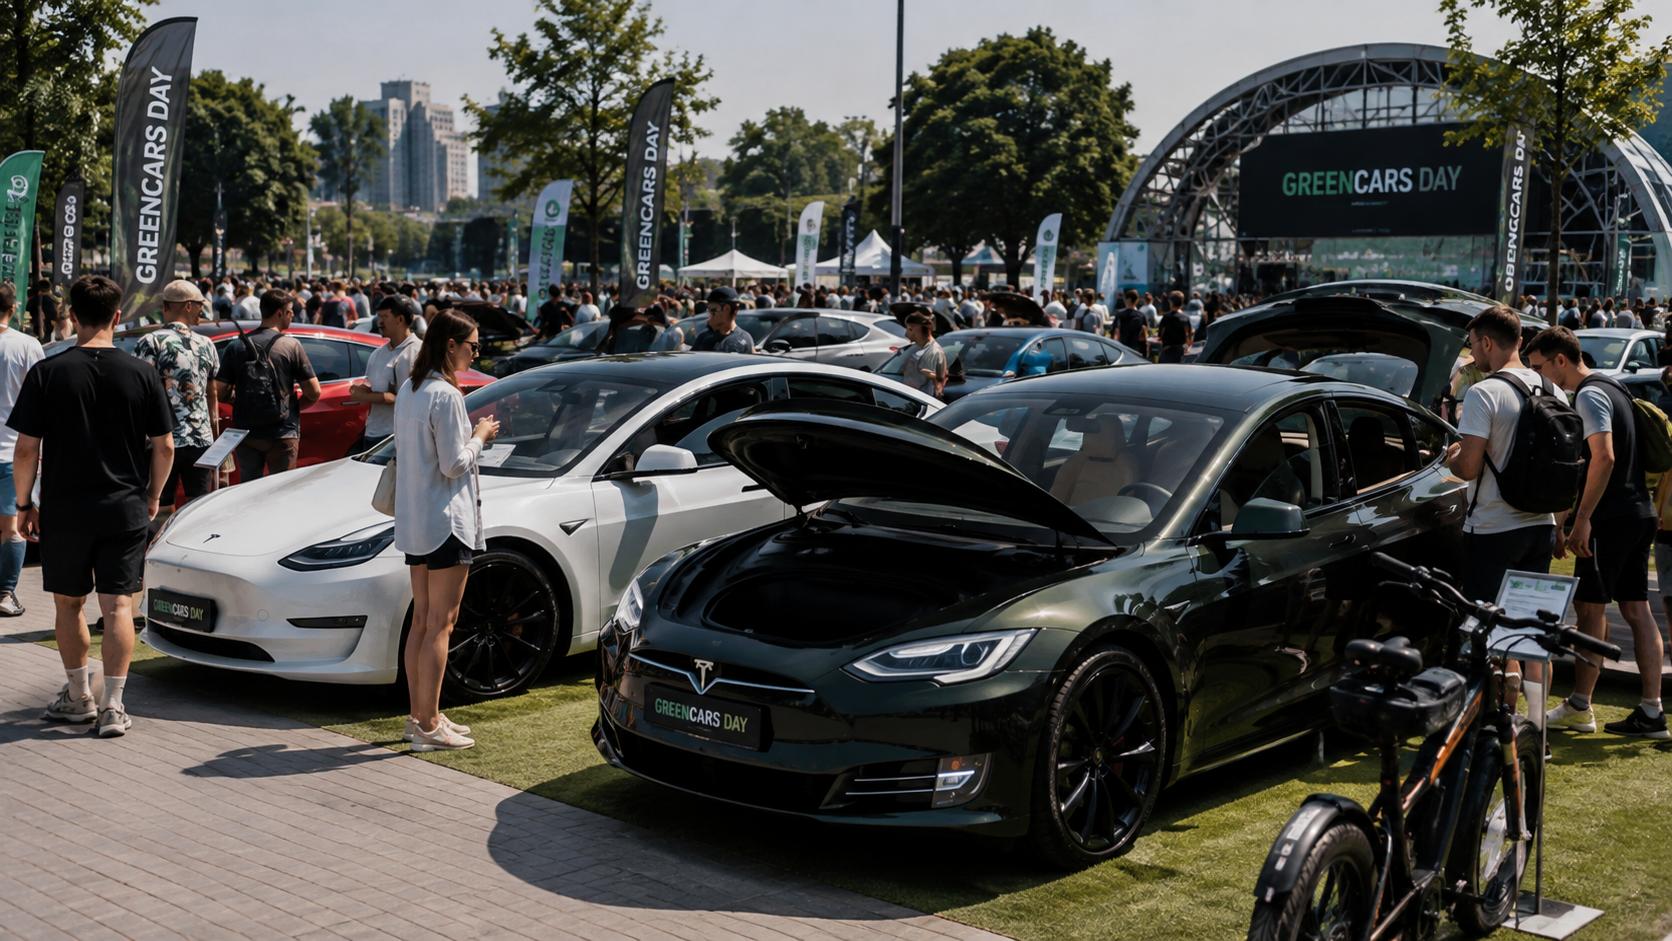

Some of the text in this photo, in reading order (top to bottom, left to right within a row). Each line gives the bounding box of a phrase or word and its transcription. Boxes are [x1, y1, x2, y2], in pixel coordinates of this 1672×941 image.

[136, 66, 172, 284] GREENCARS DAY
[1282, 165, 1462, 196] GREENCARS DAY
[636, 120, 660, 290] GREENCARS DAY
[190, 607, 204, 621] DAY
[655, 698, 748, 733] GREENCARS DAY
